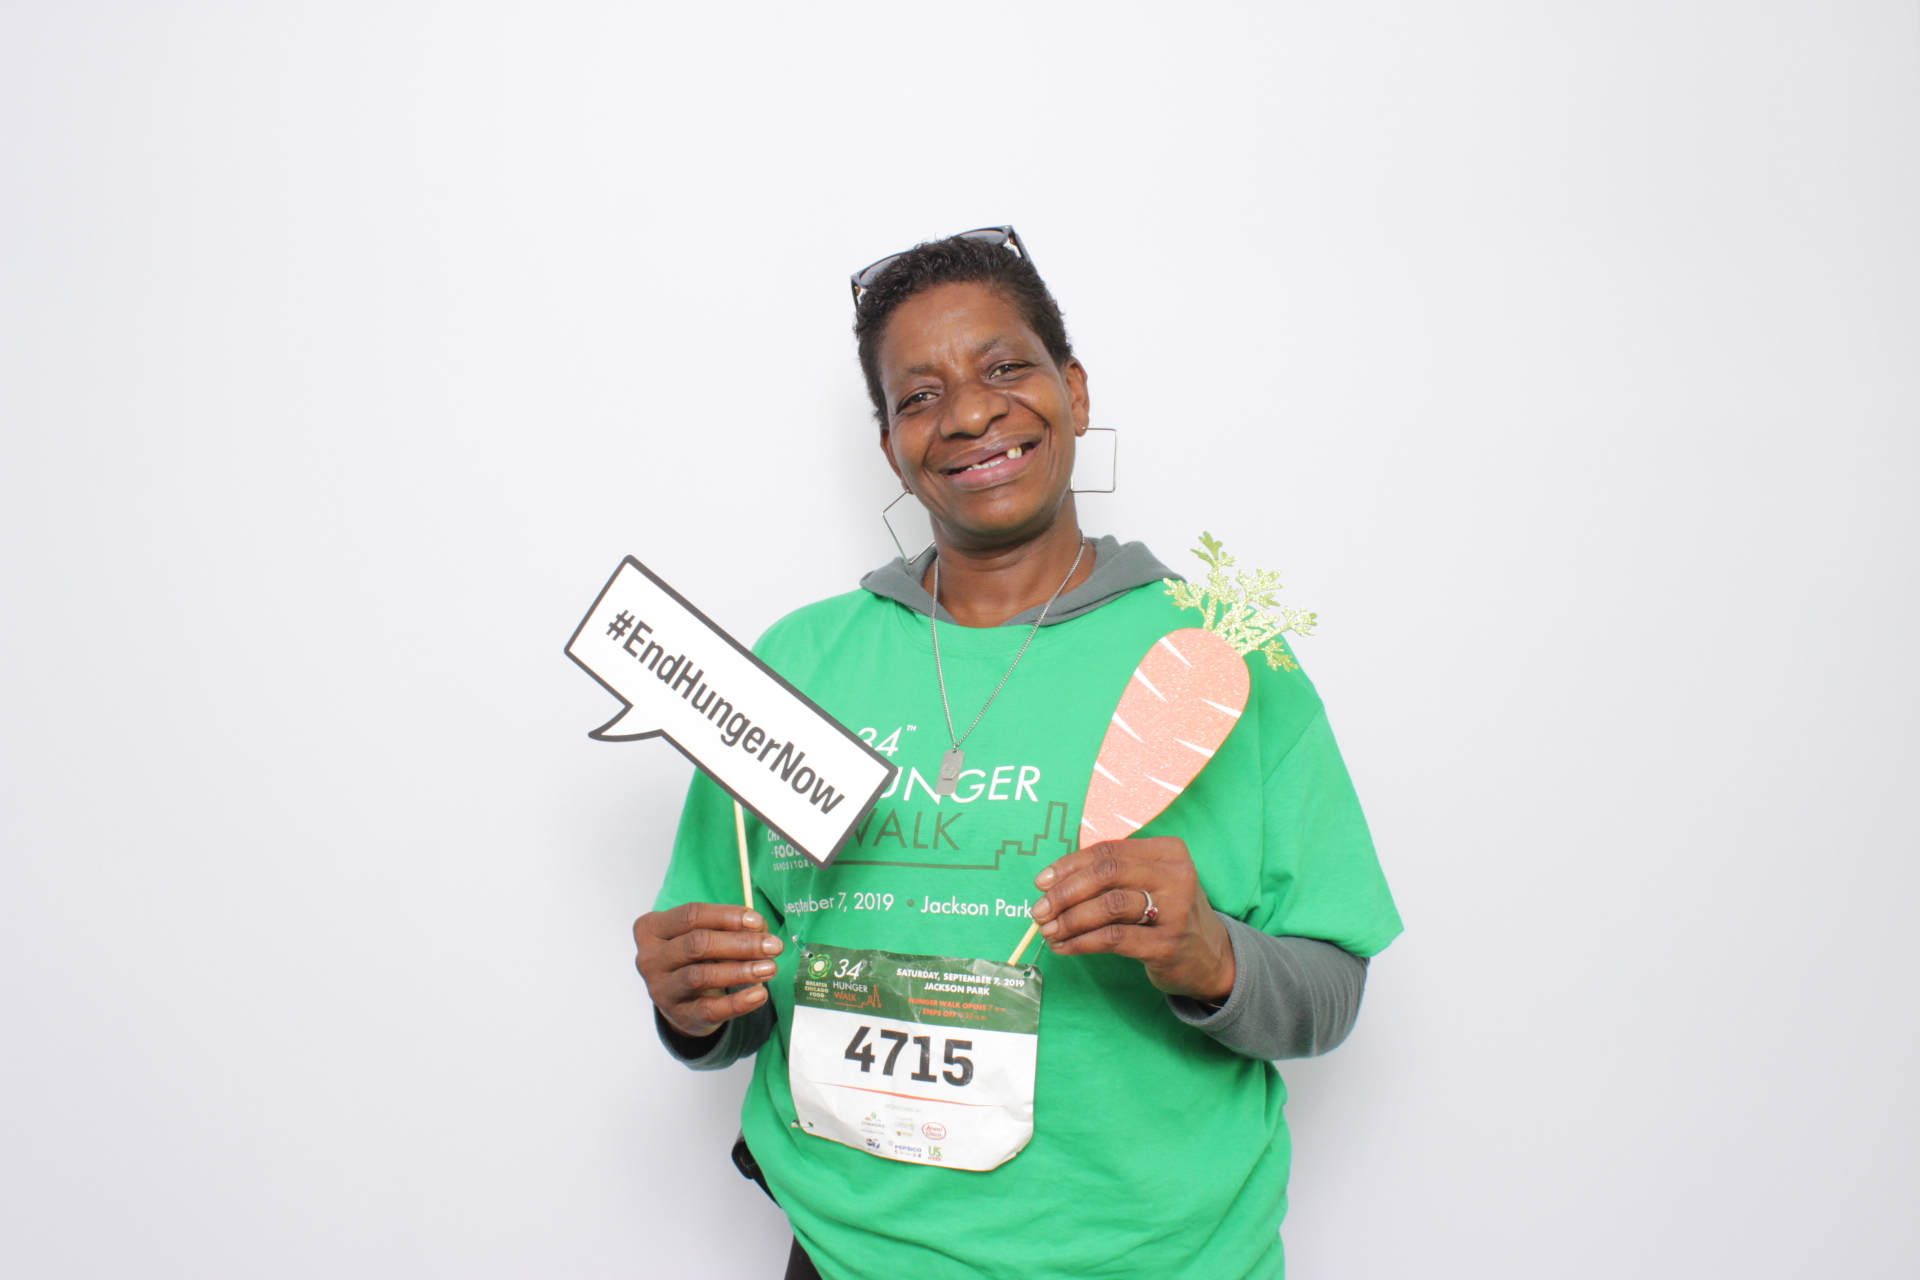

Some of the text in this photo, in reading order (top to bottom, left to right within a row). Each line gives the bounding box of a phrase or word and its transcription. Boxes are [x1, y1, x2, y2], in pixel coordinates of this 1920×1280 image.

[606, 609, 845, 815] #EndHungerNow
[880, 765, 1041, 805] UNGER
[838, 892, 848, 913] 7,
[853, 892, 895, 911] 2019
[920, 895, 989, 916] Jackson
[805, 980, 828, 988] GREATER
[896, 968, 1025, 988] SATURDAY, SEPTEMBER 7, 2019
[804, 986, 829, 994] CHICAGO
[832, 981, 868, 993] HUNGER
[924, 982, 990, 995] JACKSON PARK
[833, 991, 857, 1002] WALK
[908, 997, 938, 1006] HUNGER
[939, 1001, 961, 1009] WALK
[962, 1002, 987, 1011] OPENS
[922, 1008, 942, 1017] STEPS
[943, 1010, 957, 1018] OFF
[844, 1025, 974, 1087] 4715
[884, 1103, 915, 1113] SPONSORED
[861, 1120, 885, 1128] CONAGRA
[925, 1130, 942, 1138] Osco
[894, 1144, 922, 1153] PEPSICO
